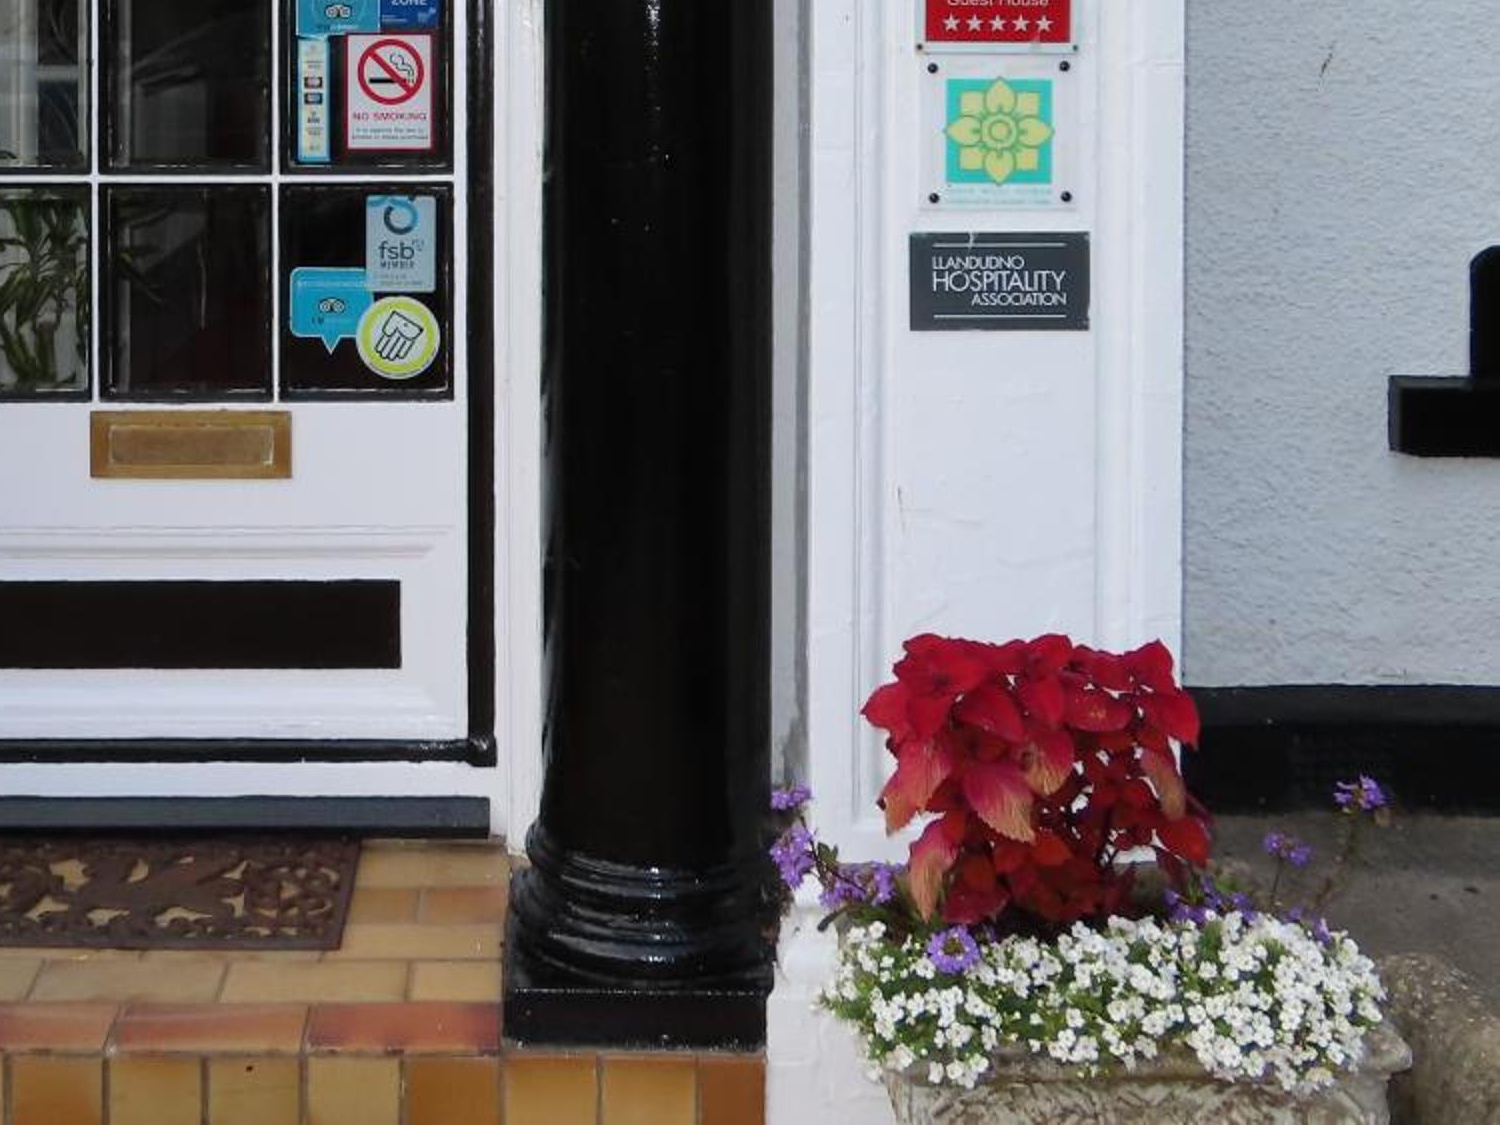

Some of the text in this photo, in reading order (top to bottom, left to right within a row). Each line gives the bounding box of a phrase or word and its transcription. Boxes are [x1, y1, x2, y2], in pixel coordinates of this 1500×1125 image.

[353, 112, 427, 121] NO SMOKING
[378, 240, 415, 260] fsb
[931, 255, 1025, 270] LLANDUDNO
[931, 270, 1067, 292] HOSPITALITY
[971, 292, 1068, 306] ASSOCIATION
